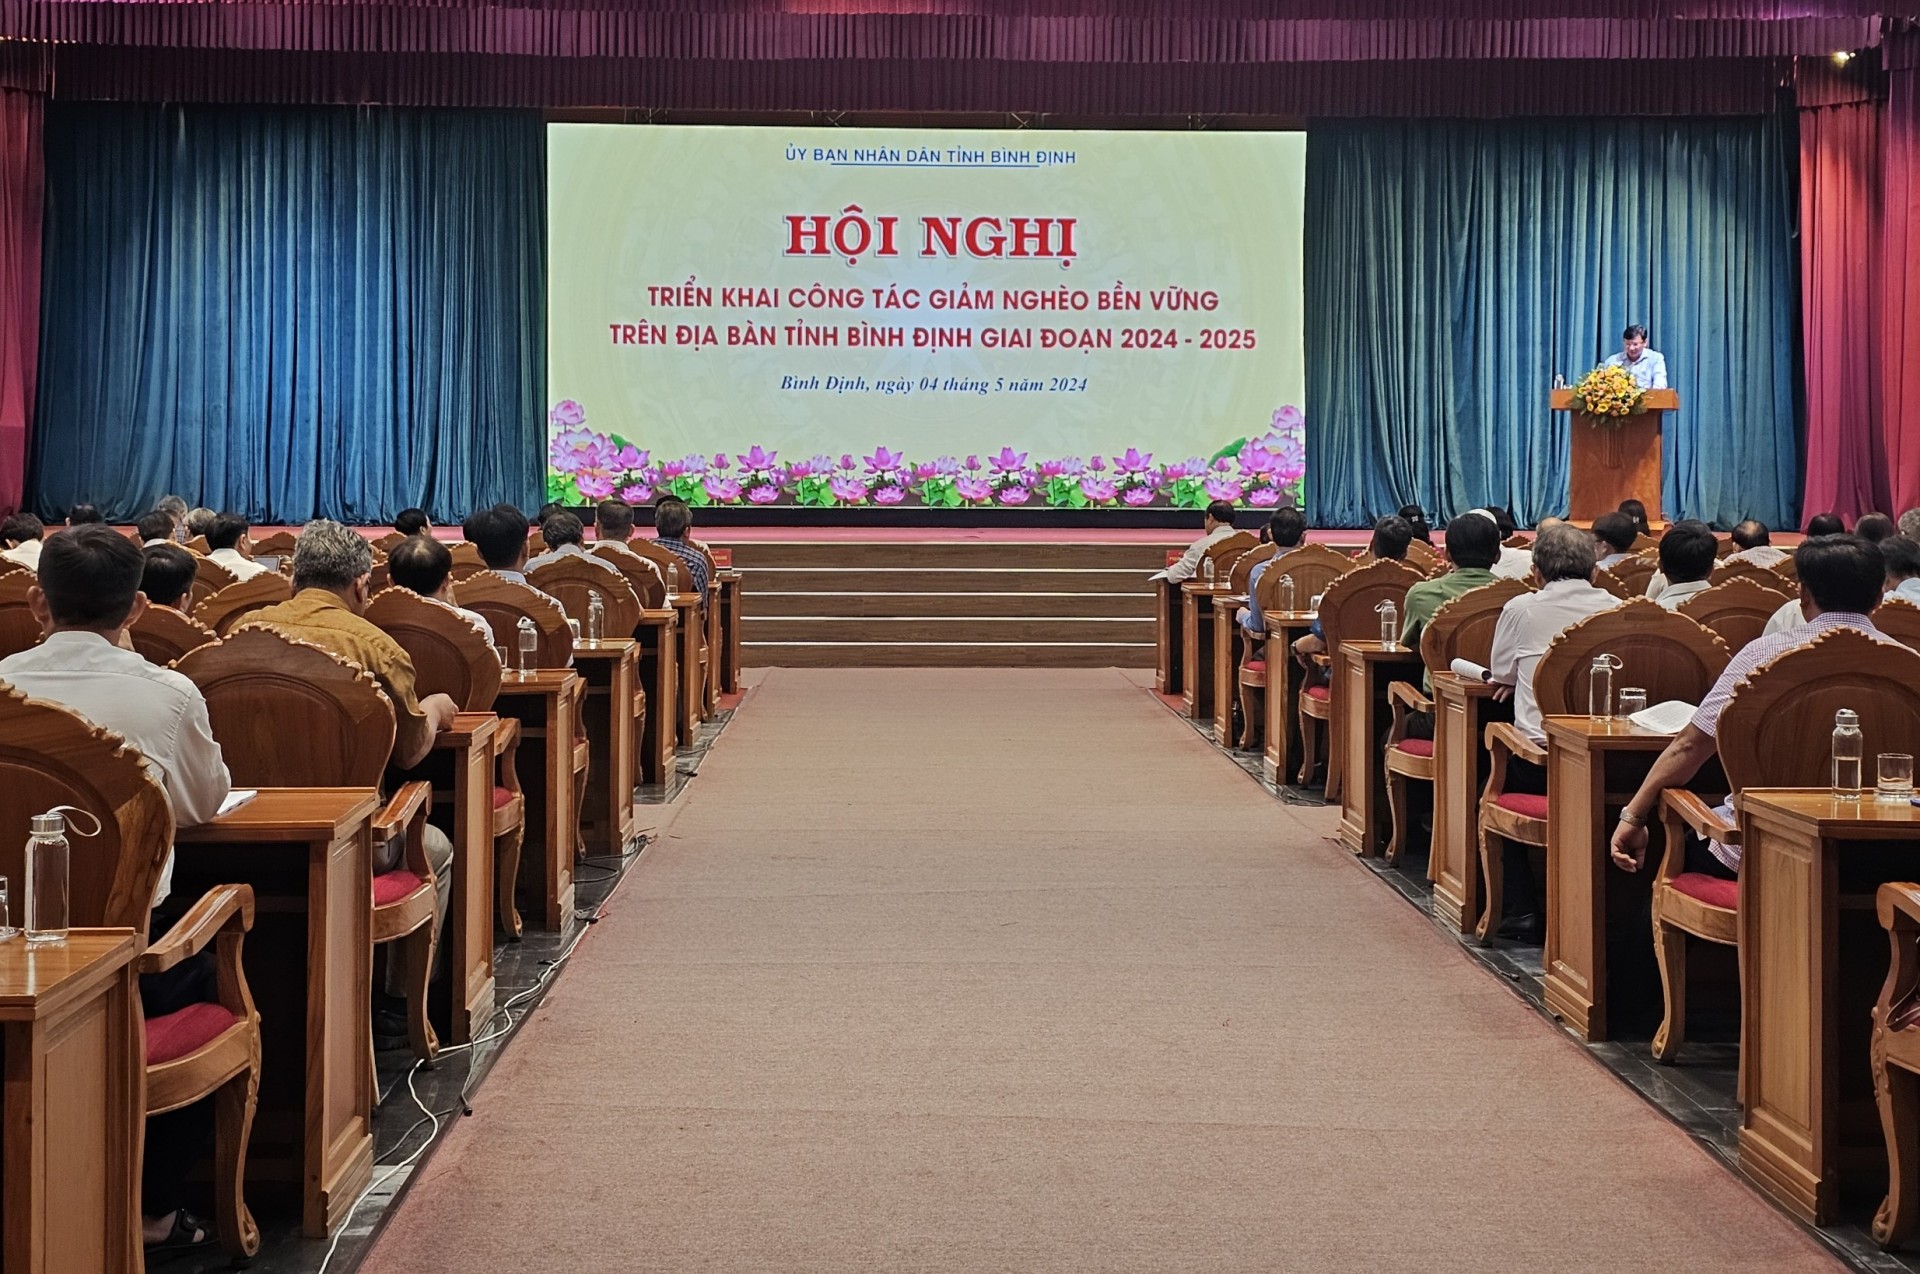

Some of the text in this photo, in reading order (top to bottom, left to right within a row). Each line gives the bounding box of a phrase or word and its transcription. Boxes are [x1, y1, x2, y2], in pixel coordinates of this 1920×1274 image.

[785, 143, 1076, 167] ỦY BAN NHÂN DÂN TỈNH BÌNH ĐỊNH
[784, 203, 1078, 268] HỘI NGHỊ
[648, 275, 1219, 311] TRIỂN KHAI CÔNG TÁC GIẢM NGHÈO BỀN VỮNG
[610, 319, 667, 345] TRÊN
[676, 325, 718, 351] ĐỊA
[727, 320, 776, 346] BÀN
[784, 319, 838, 347] TỈNH
[847, 321, 904, 348] BÌNH
[912, 327, 972, 353] ĐỊNH
[980, 328, 1032, 349] GIAI
[1040, 328, 1112, 354] ĐOẠN
[1121, 328, 1178, 349] 2024
[1199, 329, 1257, 350] 2025
[780, 375, 1089, 395] Bình Định, ngày 04 tháng 5 năm 2024
